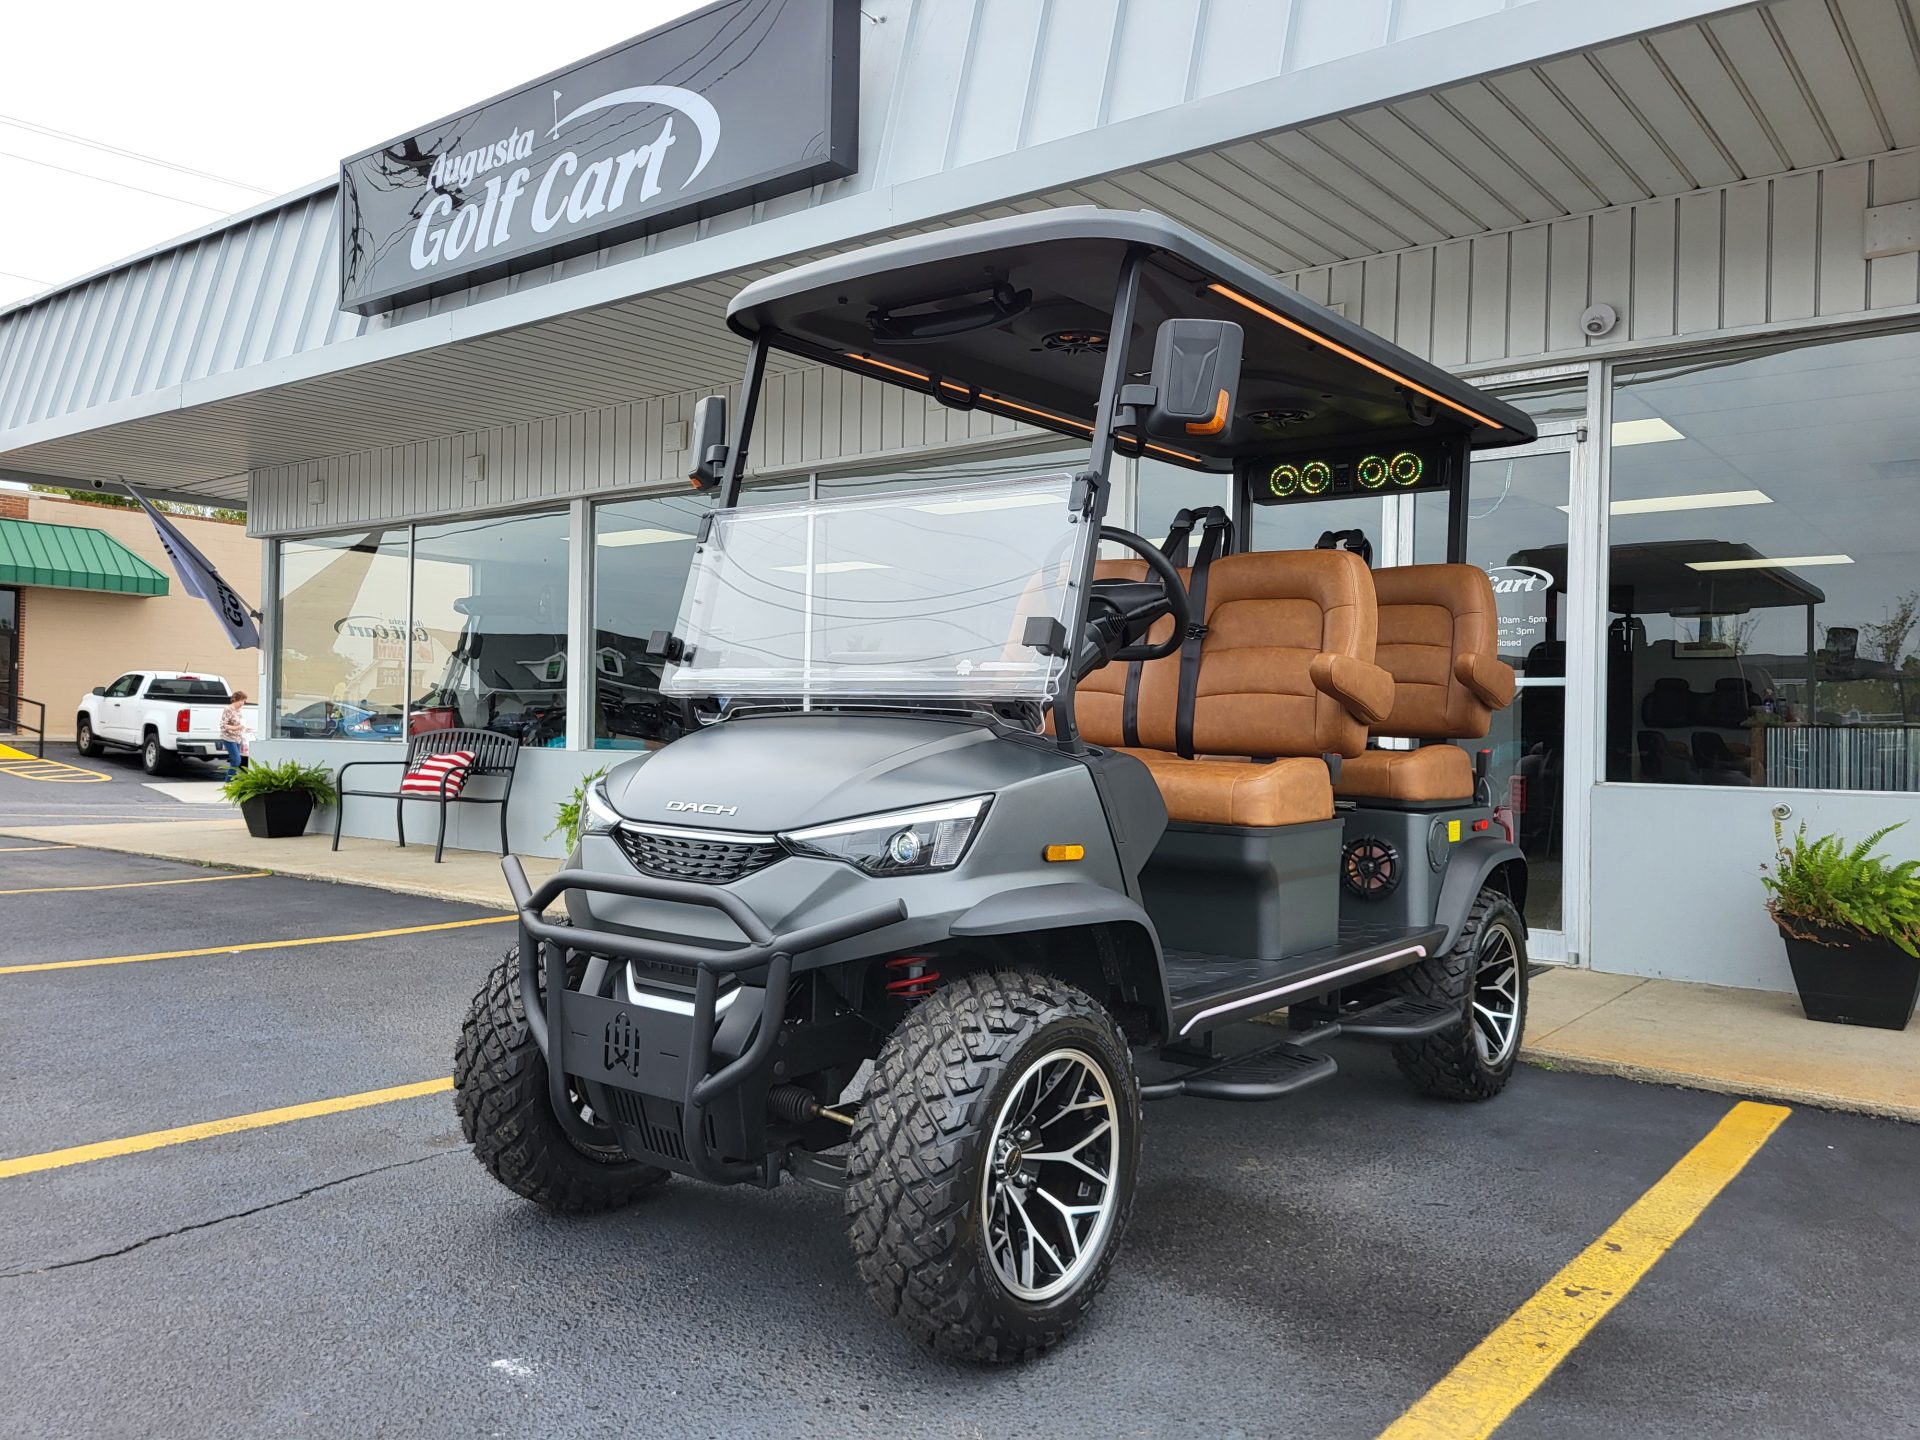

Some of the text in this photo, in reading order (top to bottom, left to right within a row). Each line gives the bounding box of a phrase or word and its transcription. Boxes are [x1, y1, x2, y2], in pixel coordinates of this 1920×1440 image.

[425, 126, 535, 189] Augusta
[409, 117, 676, 270] Golf Cart
[1528, 615, 1547, 624] 5pm
[1516, 627, 1535, 636] 3pm
[665, 800, 739, 817] DACH
